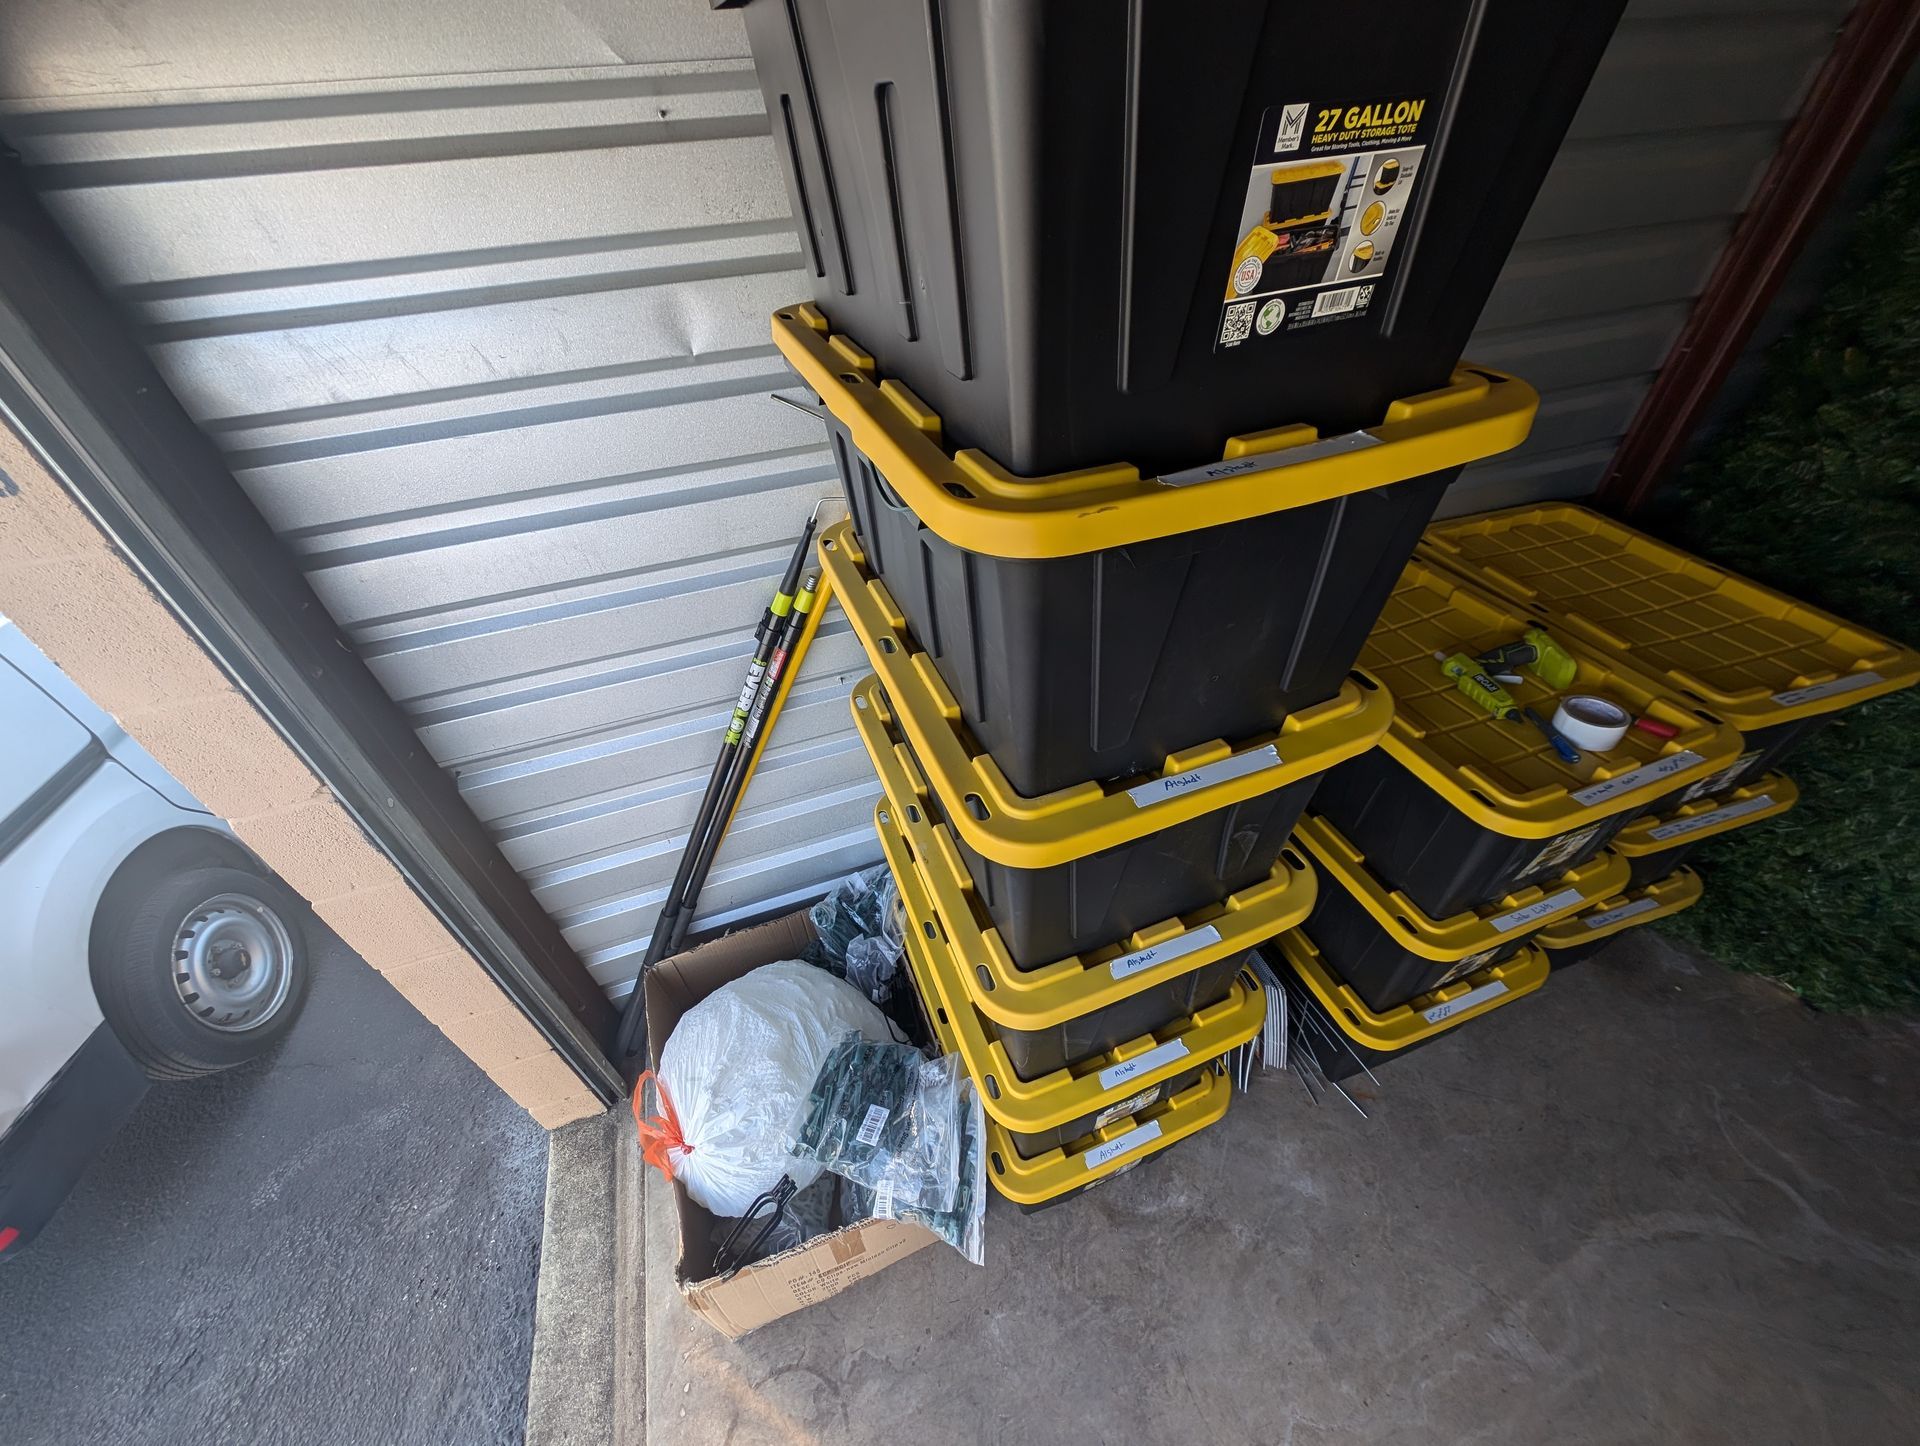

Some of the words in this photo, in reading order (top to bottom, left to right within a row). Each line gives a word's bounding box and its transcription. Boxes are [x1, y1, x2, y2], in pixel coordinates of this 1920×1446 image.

[1314, 108, 1342, 133] 27
[1344, 99, 1426, 129] GALLON
[1310, 132, 1339, 144] HEAVY
[1338, 129, 1361, 141] DUTY
[1360, 126, 1397, 138] STORAGE
[1396, 123, 1418, 135] TOTE
[1331, 142, 1348, 151] Storing
[1240, 271, 1255, 282] USA
